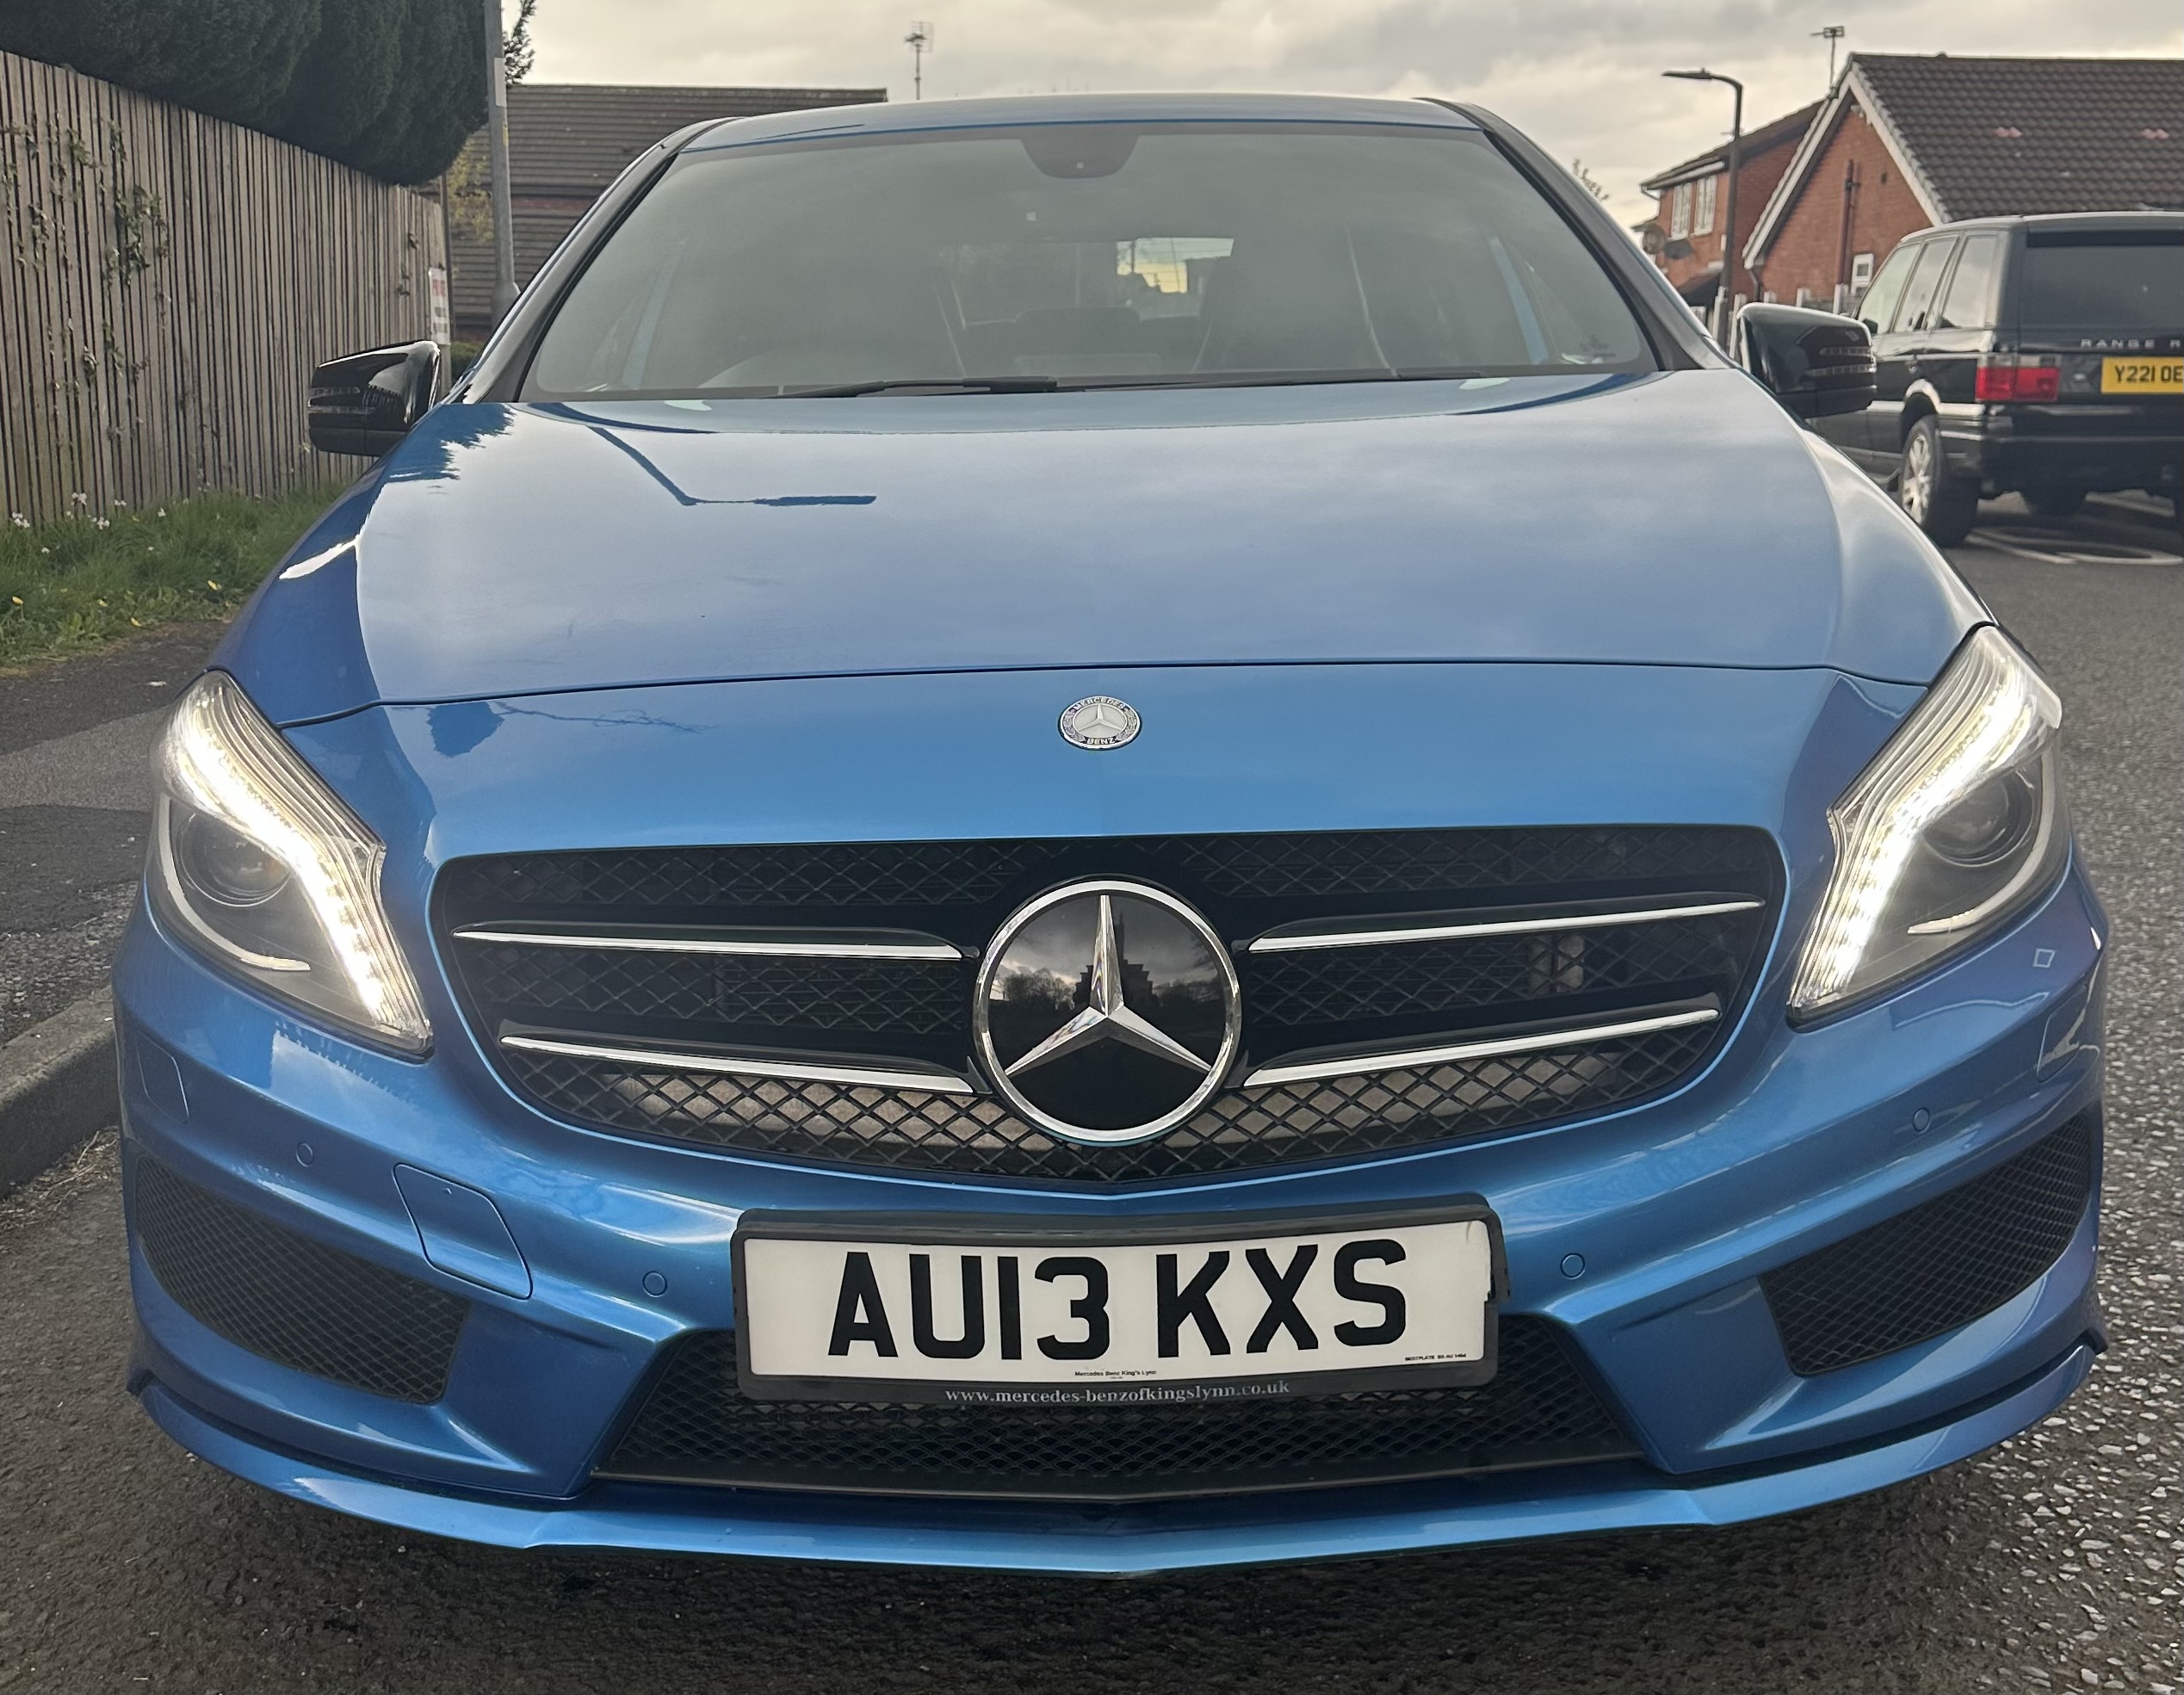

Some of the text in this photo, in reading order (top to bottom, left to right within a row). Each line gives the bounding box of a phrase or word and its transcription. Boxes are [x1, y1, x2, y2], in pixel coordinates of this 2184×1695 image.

[2080, 338, 2155, 350] RANGE
[2114, 364, 2156, 383] Y221
[1073, 696, 1126, 710] MERCEDES
[1086, 737, 1117, 745] BENZ
[828, 1239, 1408, 1360] AU13 KXS
[945, 1380, 1290, 1402] www.mercedes-benzofkingslynn.co.uk
